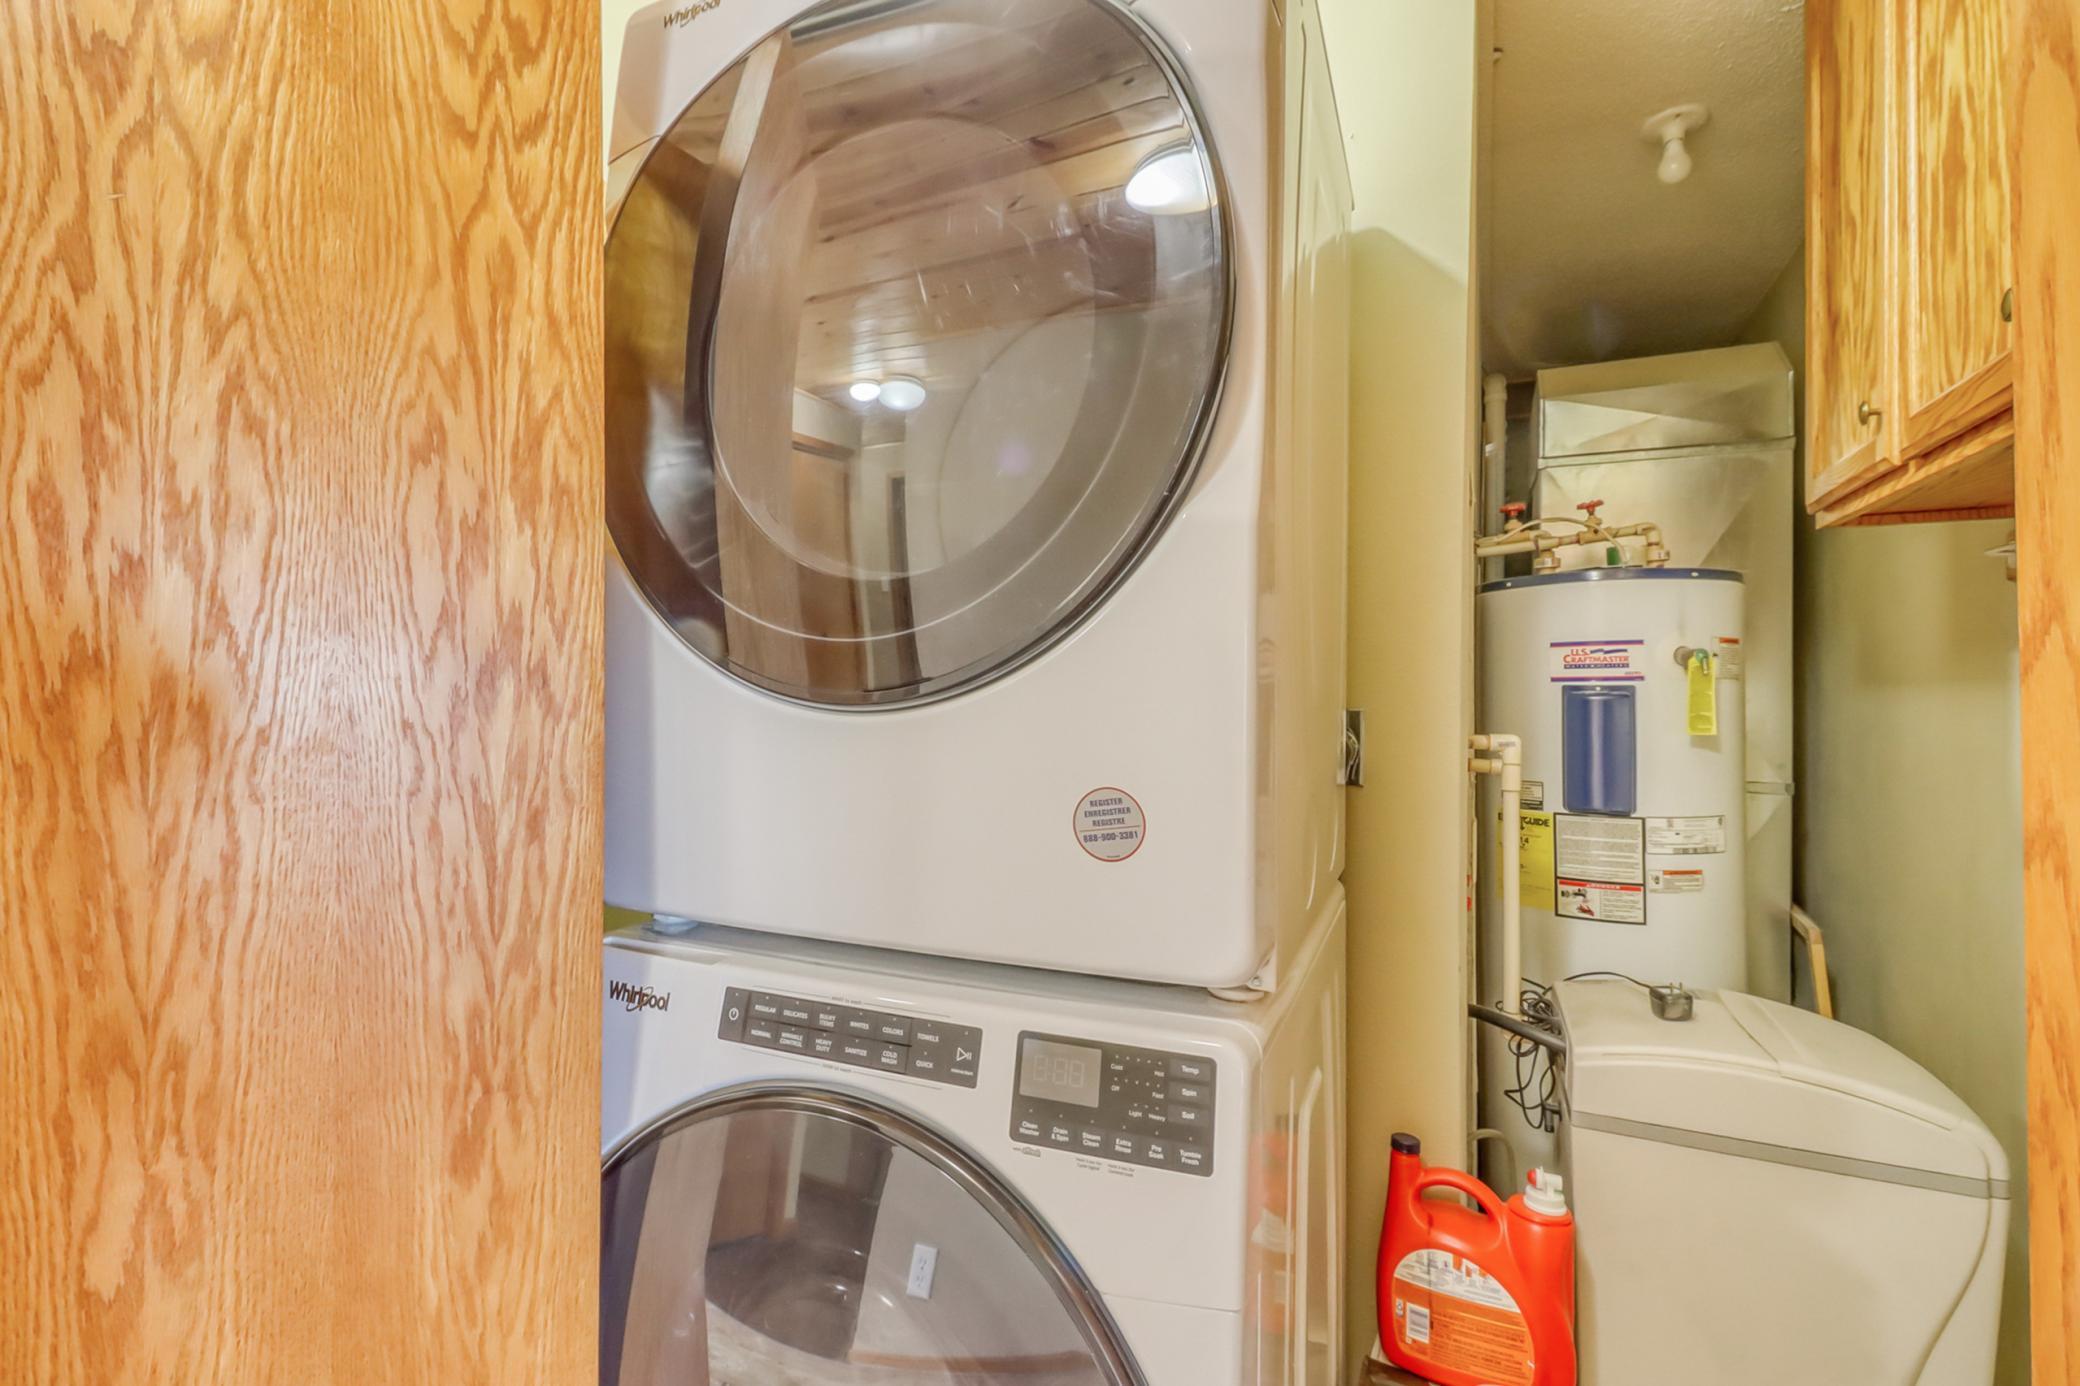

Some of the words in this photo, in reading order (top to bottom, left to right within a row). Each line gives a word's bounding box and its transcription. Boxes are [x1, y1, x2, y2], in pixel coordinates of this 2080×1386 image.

[1089, 797, 1123, 807] REGISTER
[1084, 807, 1131, 818] ENREGISTRER
[1092, 817, 1125, 827] REGISTRE
[609, 979, 671, 1013] Whirlpool
[917, 1032, 940, 1043] TOWELS
[1181, 1065, 1199, 1075] Temp
[1182, 1088, 1198, 1097] Spin
[1128, 1109, 1143, 1118] Light
